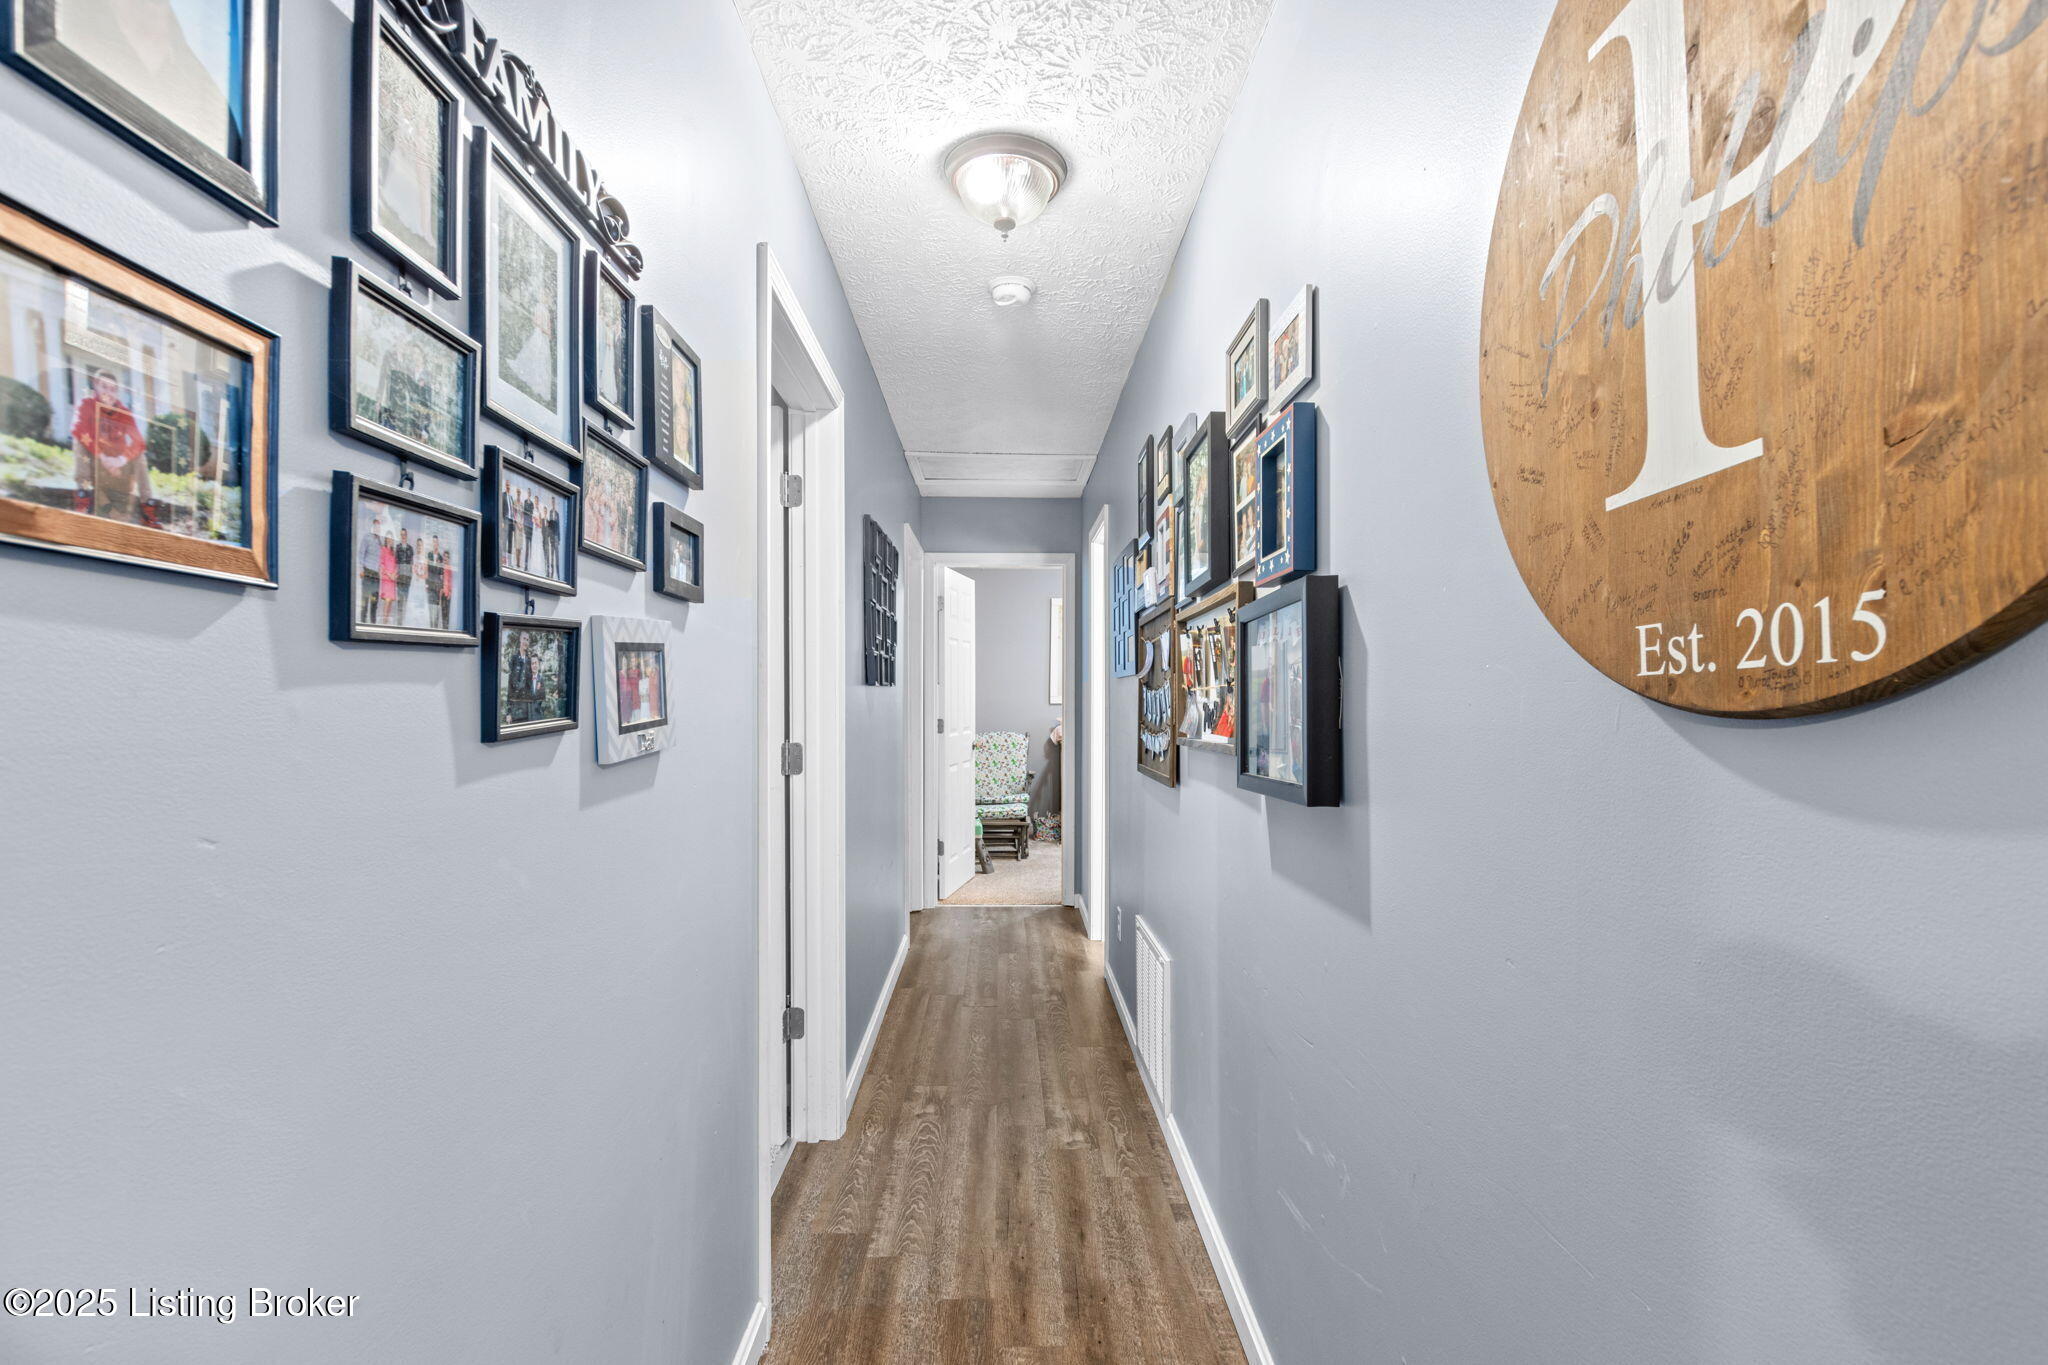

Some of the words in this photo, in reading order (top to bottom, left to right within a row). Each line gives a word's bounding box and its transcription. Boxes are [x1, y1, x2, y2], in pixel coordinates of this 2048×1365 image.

[452, 0, 601, 220] FAMILY
[1635, 622, 1717, 678] Est.
[1736, 588, 1888, 670] 2015
